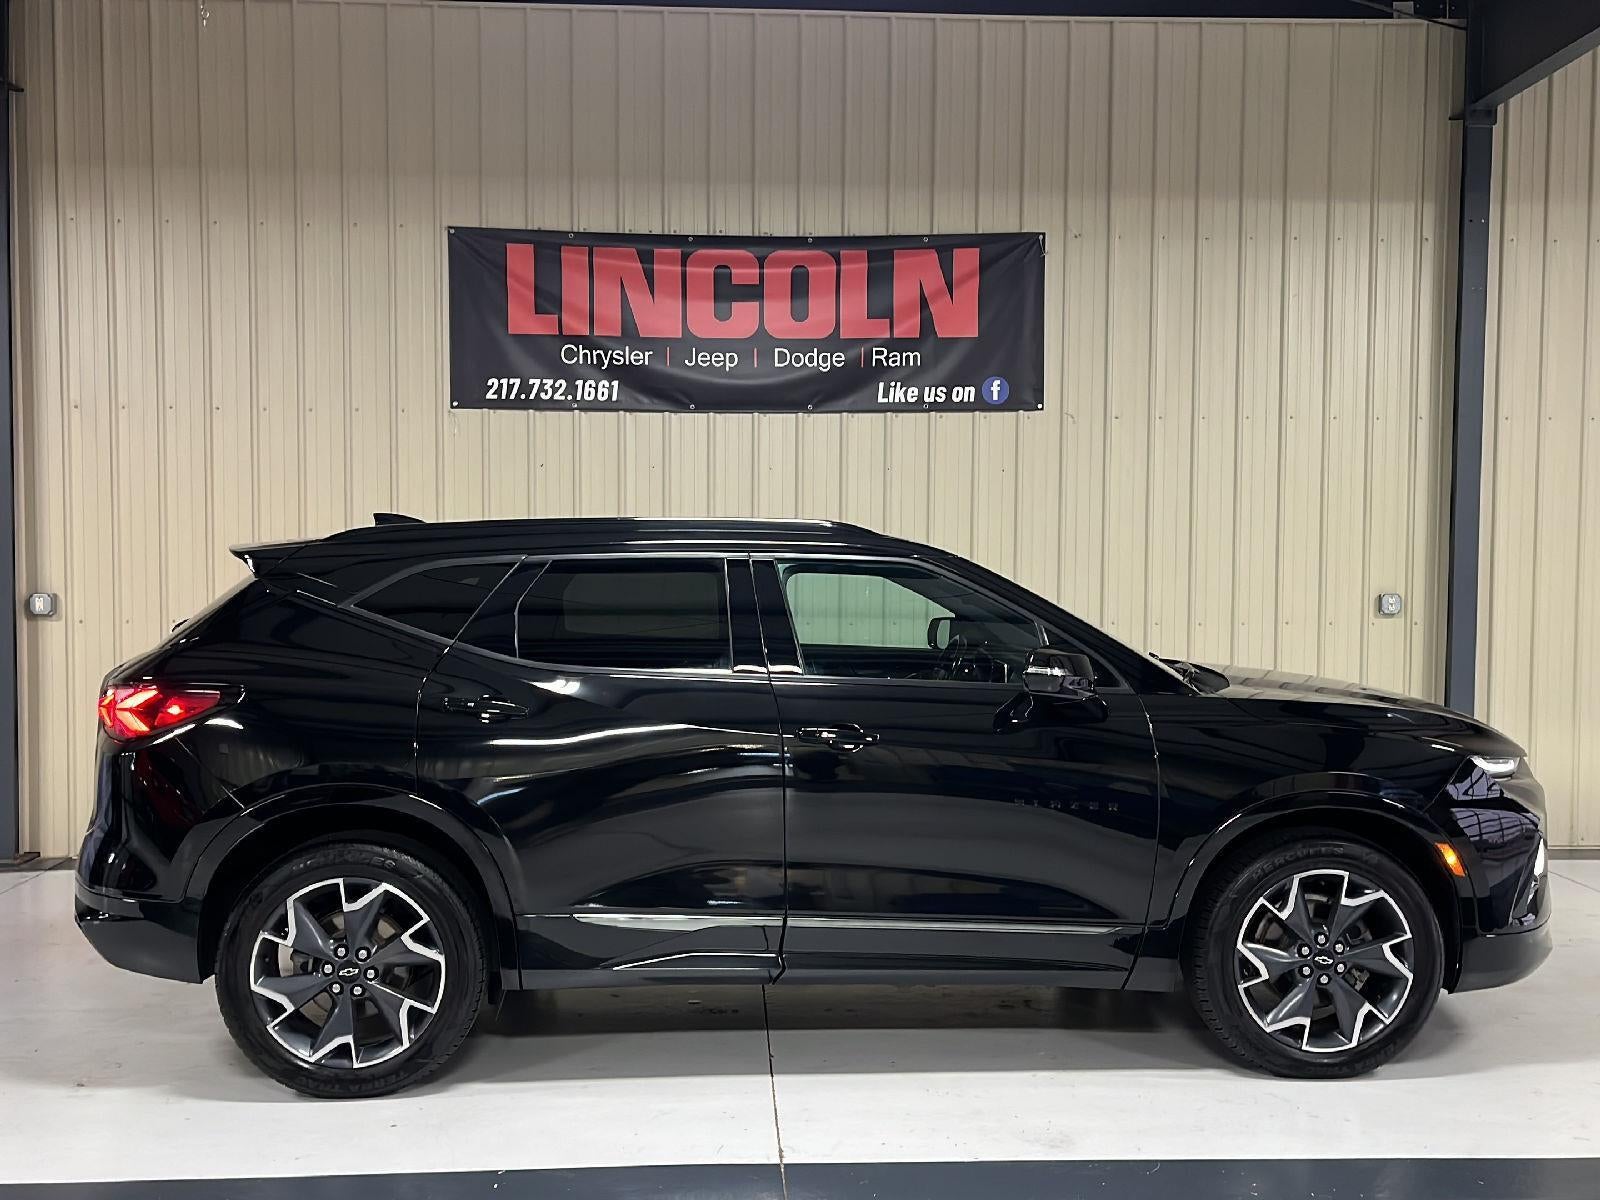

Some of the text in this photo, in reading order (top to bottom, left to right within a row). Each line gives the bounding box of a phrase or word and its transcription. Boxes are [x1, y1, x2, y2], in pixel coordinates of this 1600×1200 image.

[505, 243, 980, 340] LINCOLN
[560, 344, 922, 372] Chrysler Jeep Dodge Ram
[485, 377, 620, 402] 217.732.1661
[877, 381, 919, 403] Like
[923, 385, 947, 403] us
[951, 385, 976, 403] on
